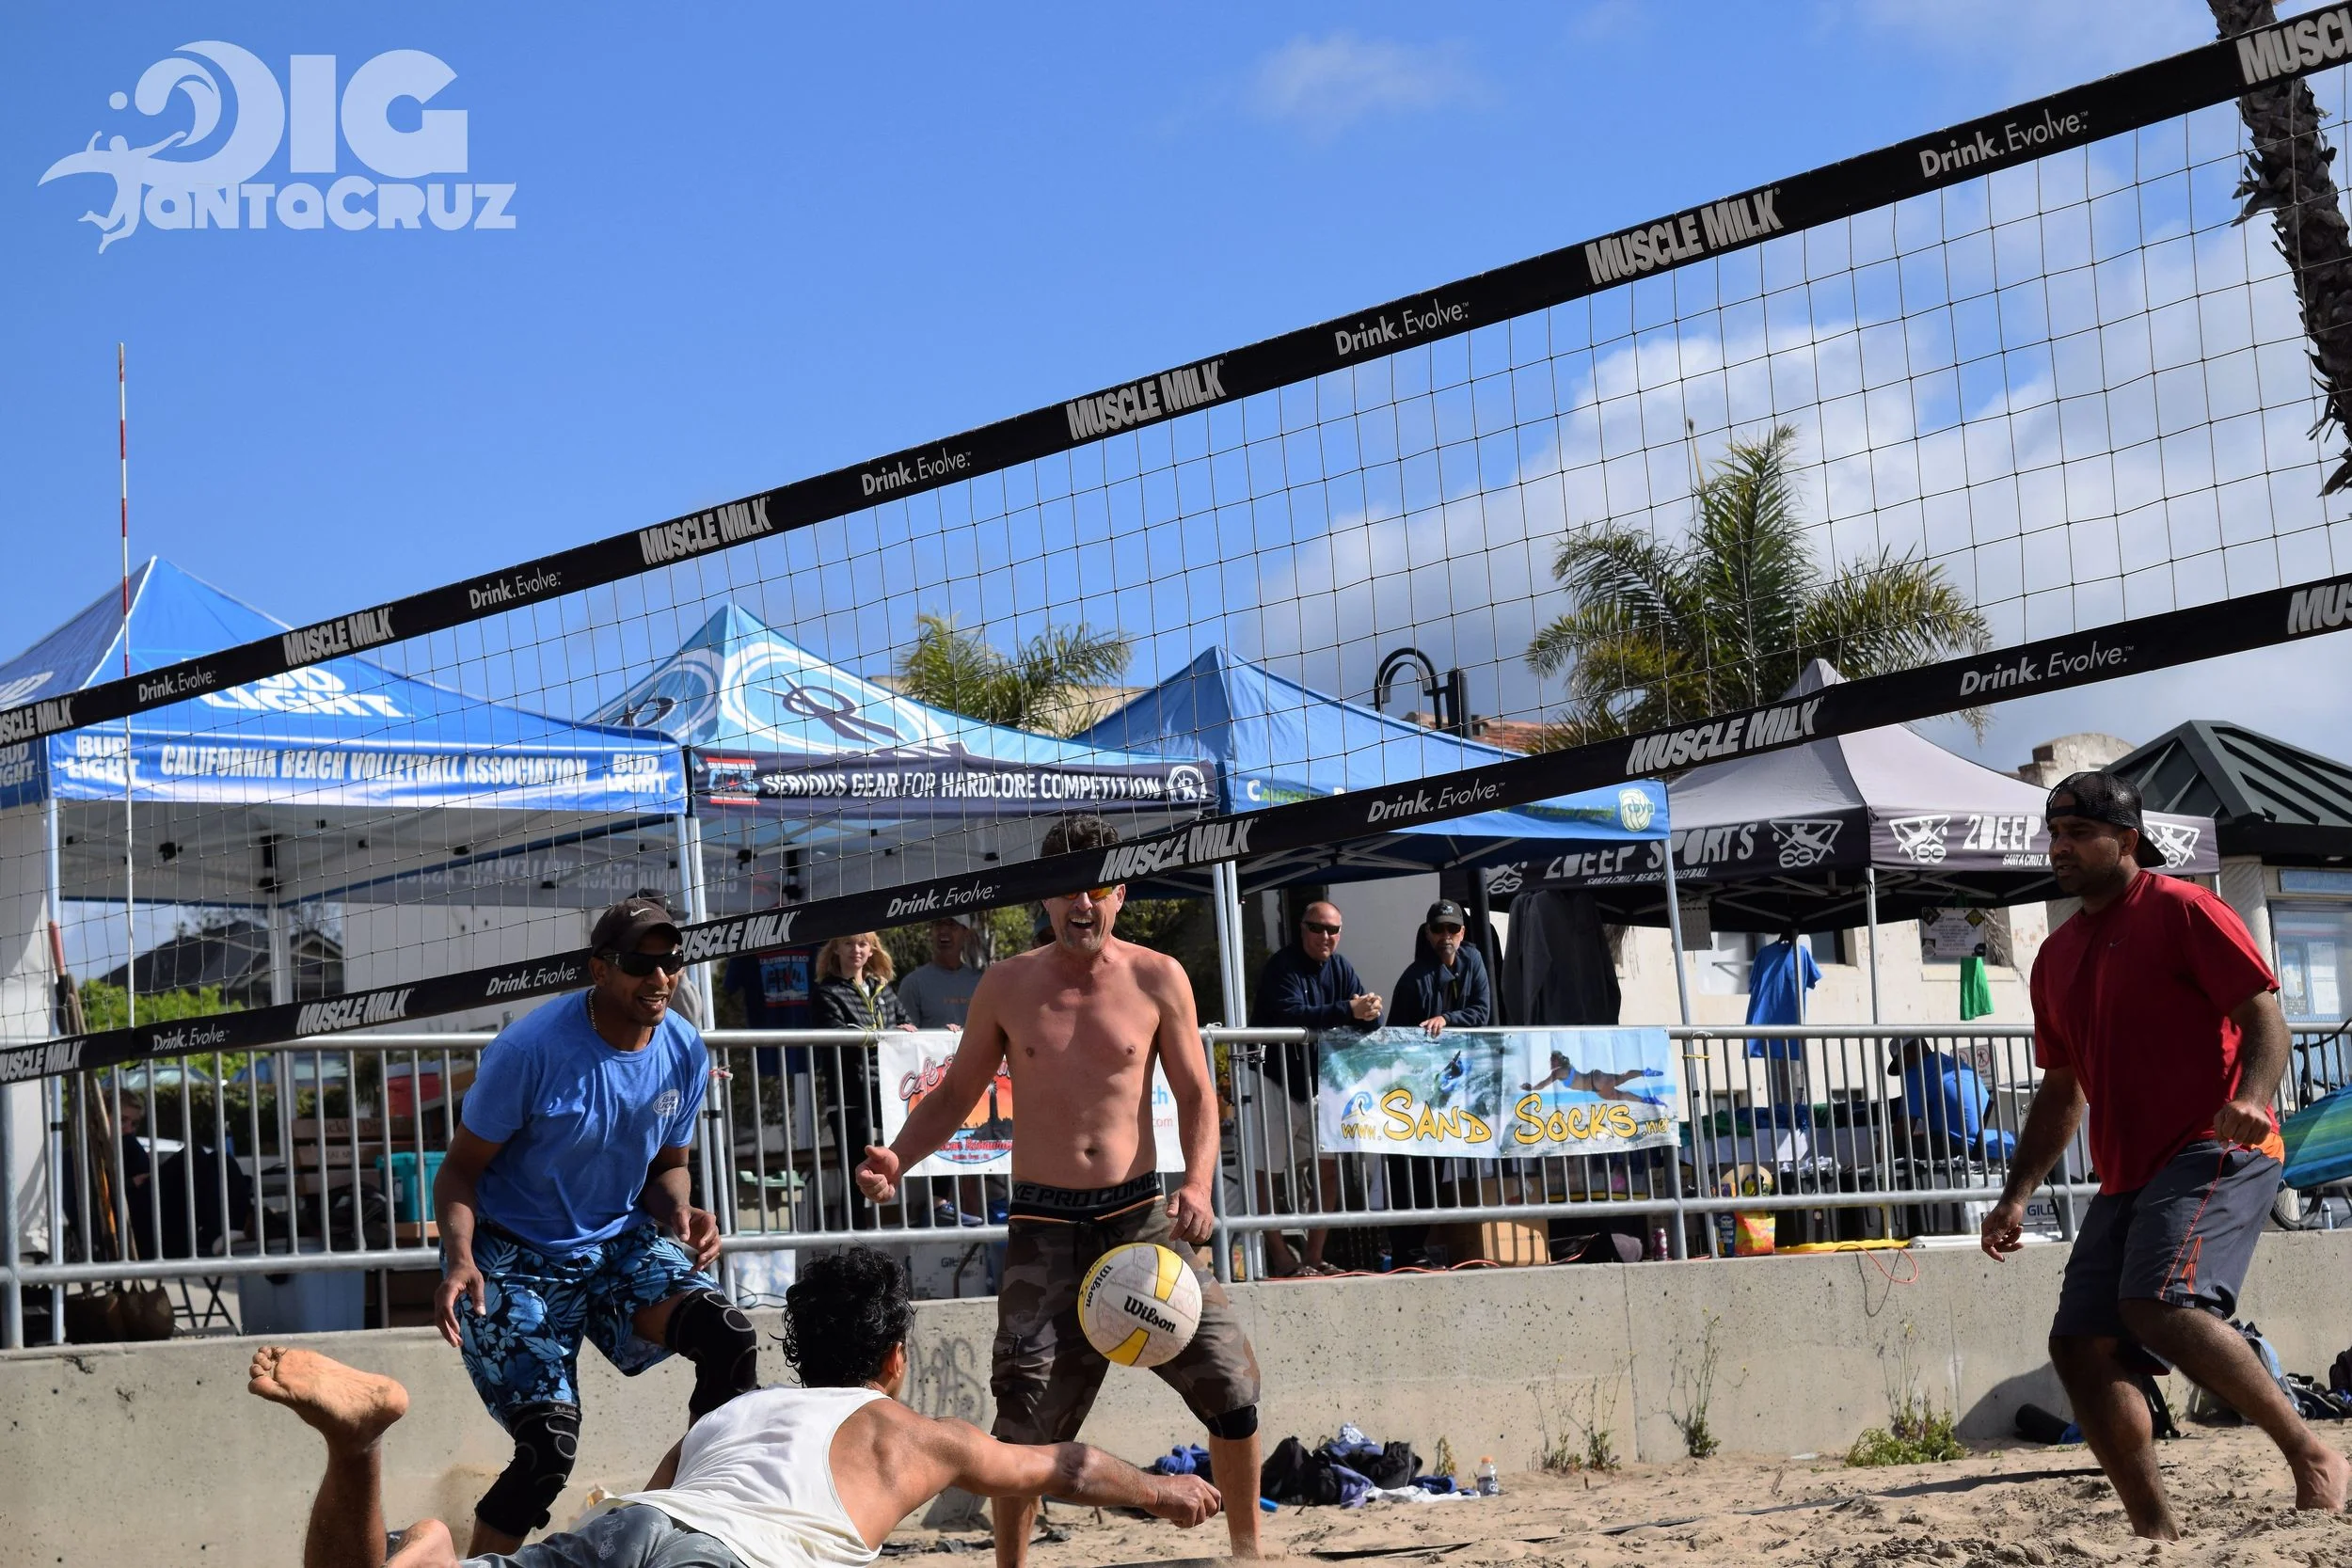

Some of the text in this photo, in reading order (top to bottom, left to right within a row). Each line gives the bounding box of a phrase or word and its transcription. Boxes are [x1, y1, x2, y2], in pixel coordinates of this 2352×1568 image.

[2235, 7, 2352, 86] MUSCL
[1919, 132, 2005, 178] Drink.
[1585, 188, 1784, 284] MUSCLE MILK
[1335, 316, 1403, 356] Drink.
[1066, 361, 1226, 440] MUSCLE MILK
[862, 463, 916, 496] Drink.
[640, 498, 772, 564] MUSCLE MILK
[469, 579, 516, 610] Drink.
[283, 607, 394, 666] MUSCLE MILK
[138, 675, 178, 704] Drink.
[1960, 657, 2042, 697] Drink.
[0, 698, 74, 745] SCLE MILK
[1626, 697, 1821, 775] MUSCLE MILK
[76, 735, 128, 758] BUD
[161, 744, 588, 786] CALIFORNIA BEACH VOLLEYBALL ASSOCIATION
[612, 753, 659, 775] BUD
[763, 771, 1160, 800] SERIOUS GEAR FOR HARDCORE COMPETITION
[1367, 790, 1435, 824] Drink.
[1187, 818, 1254, 863] MILK
[1963, 815, 2042, 851] 2DEEP
[2002, 854, 2024, 866] SANTA
[2025, 854, 2042, 866] CRUZ
[886, 889, 940, 918] Drink.
[740, 912, 793, 951] MILK
[486, 970, 532, 997] Drink.
[296, 989, 412, 1036] MUSCLE MILK
[0, 1041, 83, 1083] USCLE MILK
[1342, 1122, 1382, 1141] www.
[1380, 1088, 1492, 1144] SAND
[1514, 1093, 1639, 1144] SOCKS
[1085, 1264, 1114, 1308] Wilson
[1124, 1295, 1177, 1334] Wilson
